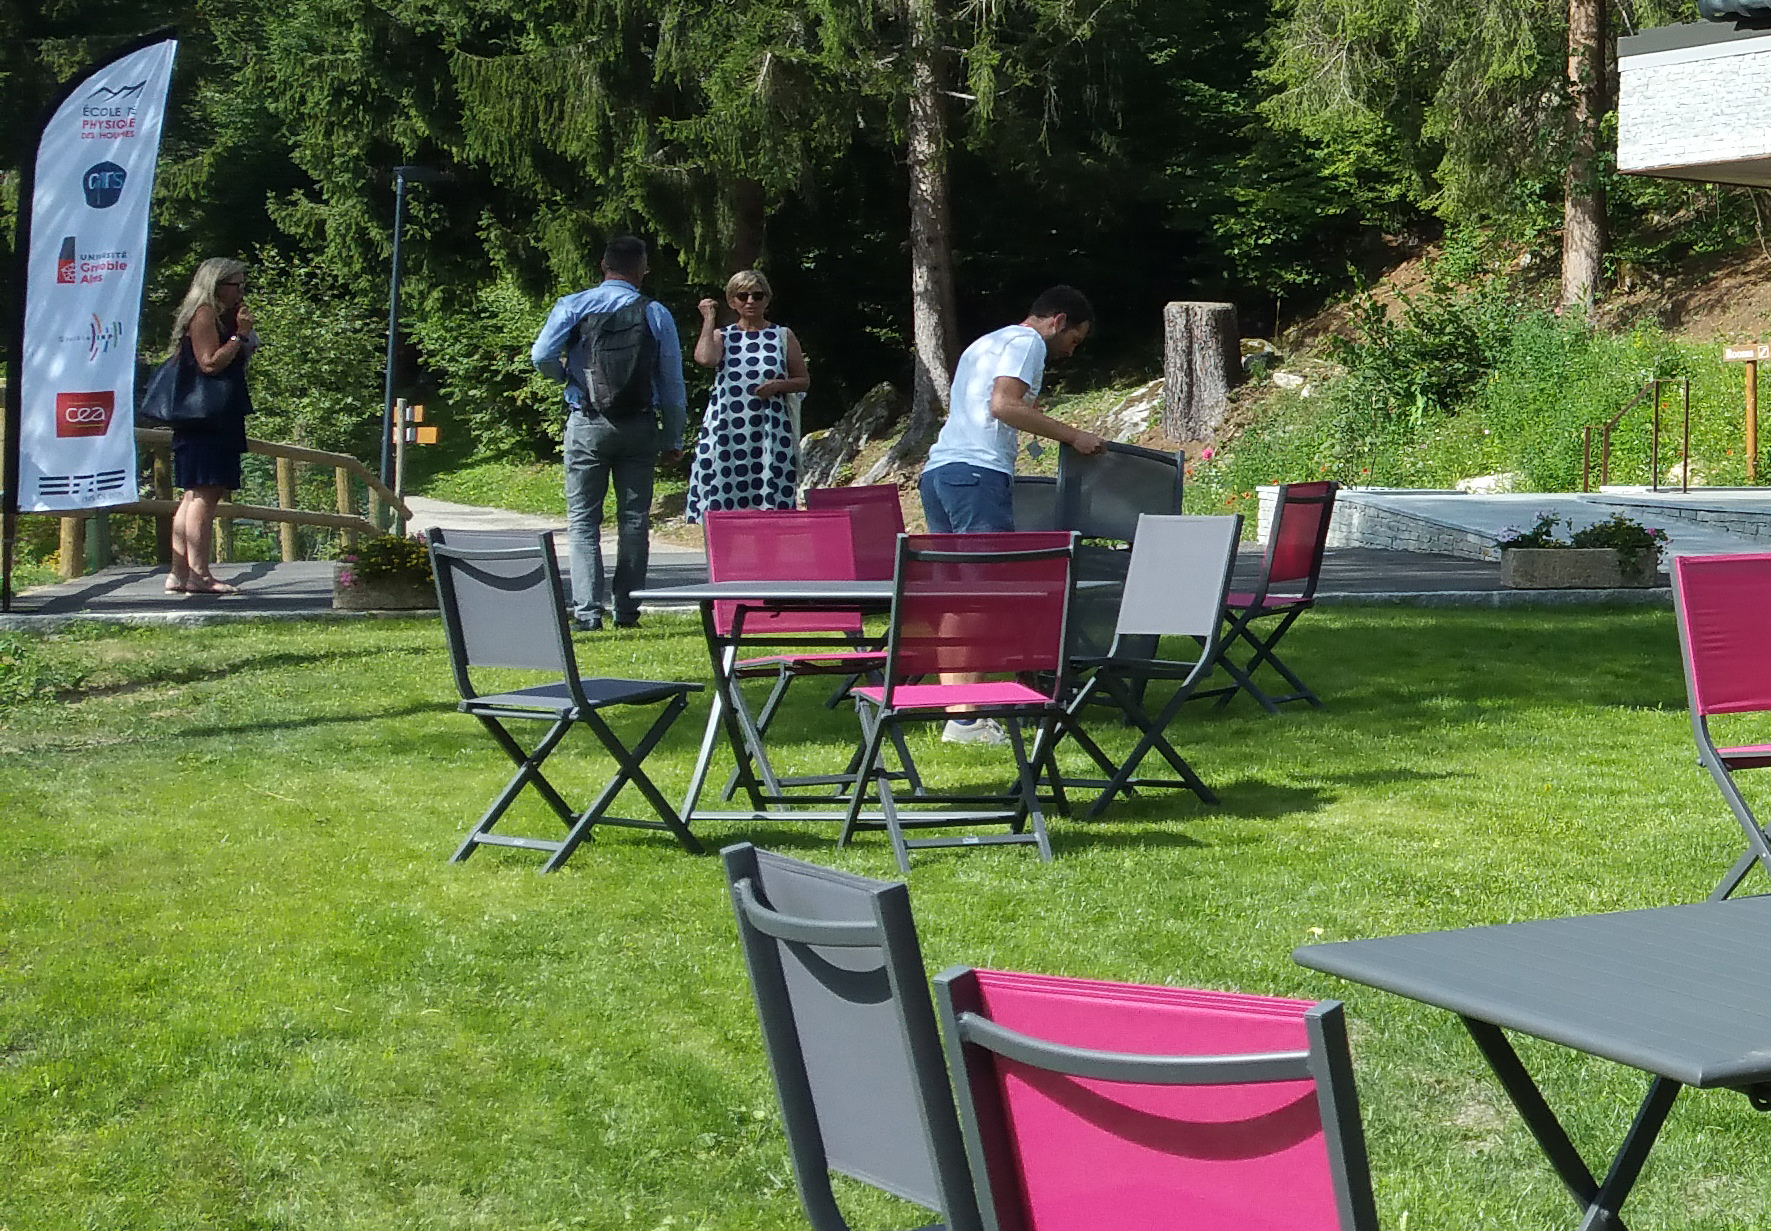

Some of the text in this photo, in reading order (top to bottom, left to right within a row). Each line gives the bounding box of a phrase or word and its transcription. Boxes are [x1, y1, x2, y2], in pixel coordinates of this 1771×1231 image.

[82, 118, 137, 129] PHYSIQE
[80, 260, 128, 273] Groble
[65, 406, 106, 423] cea
